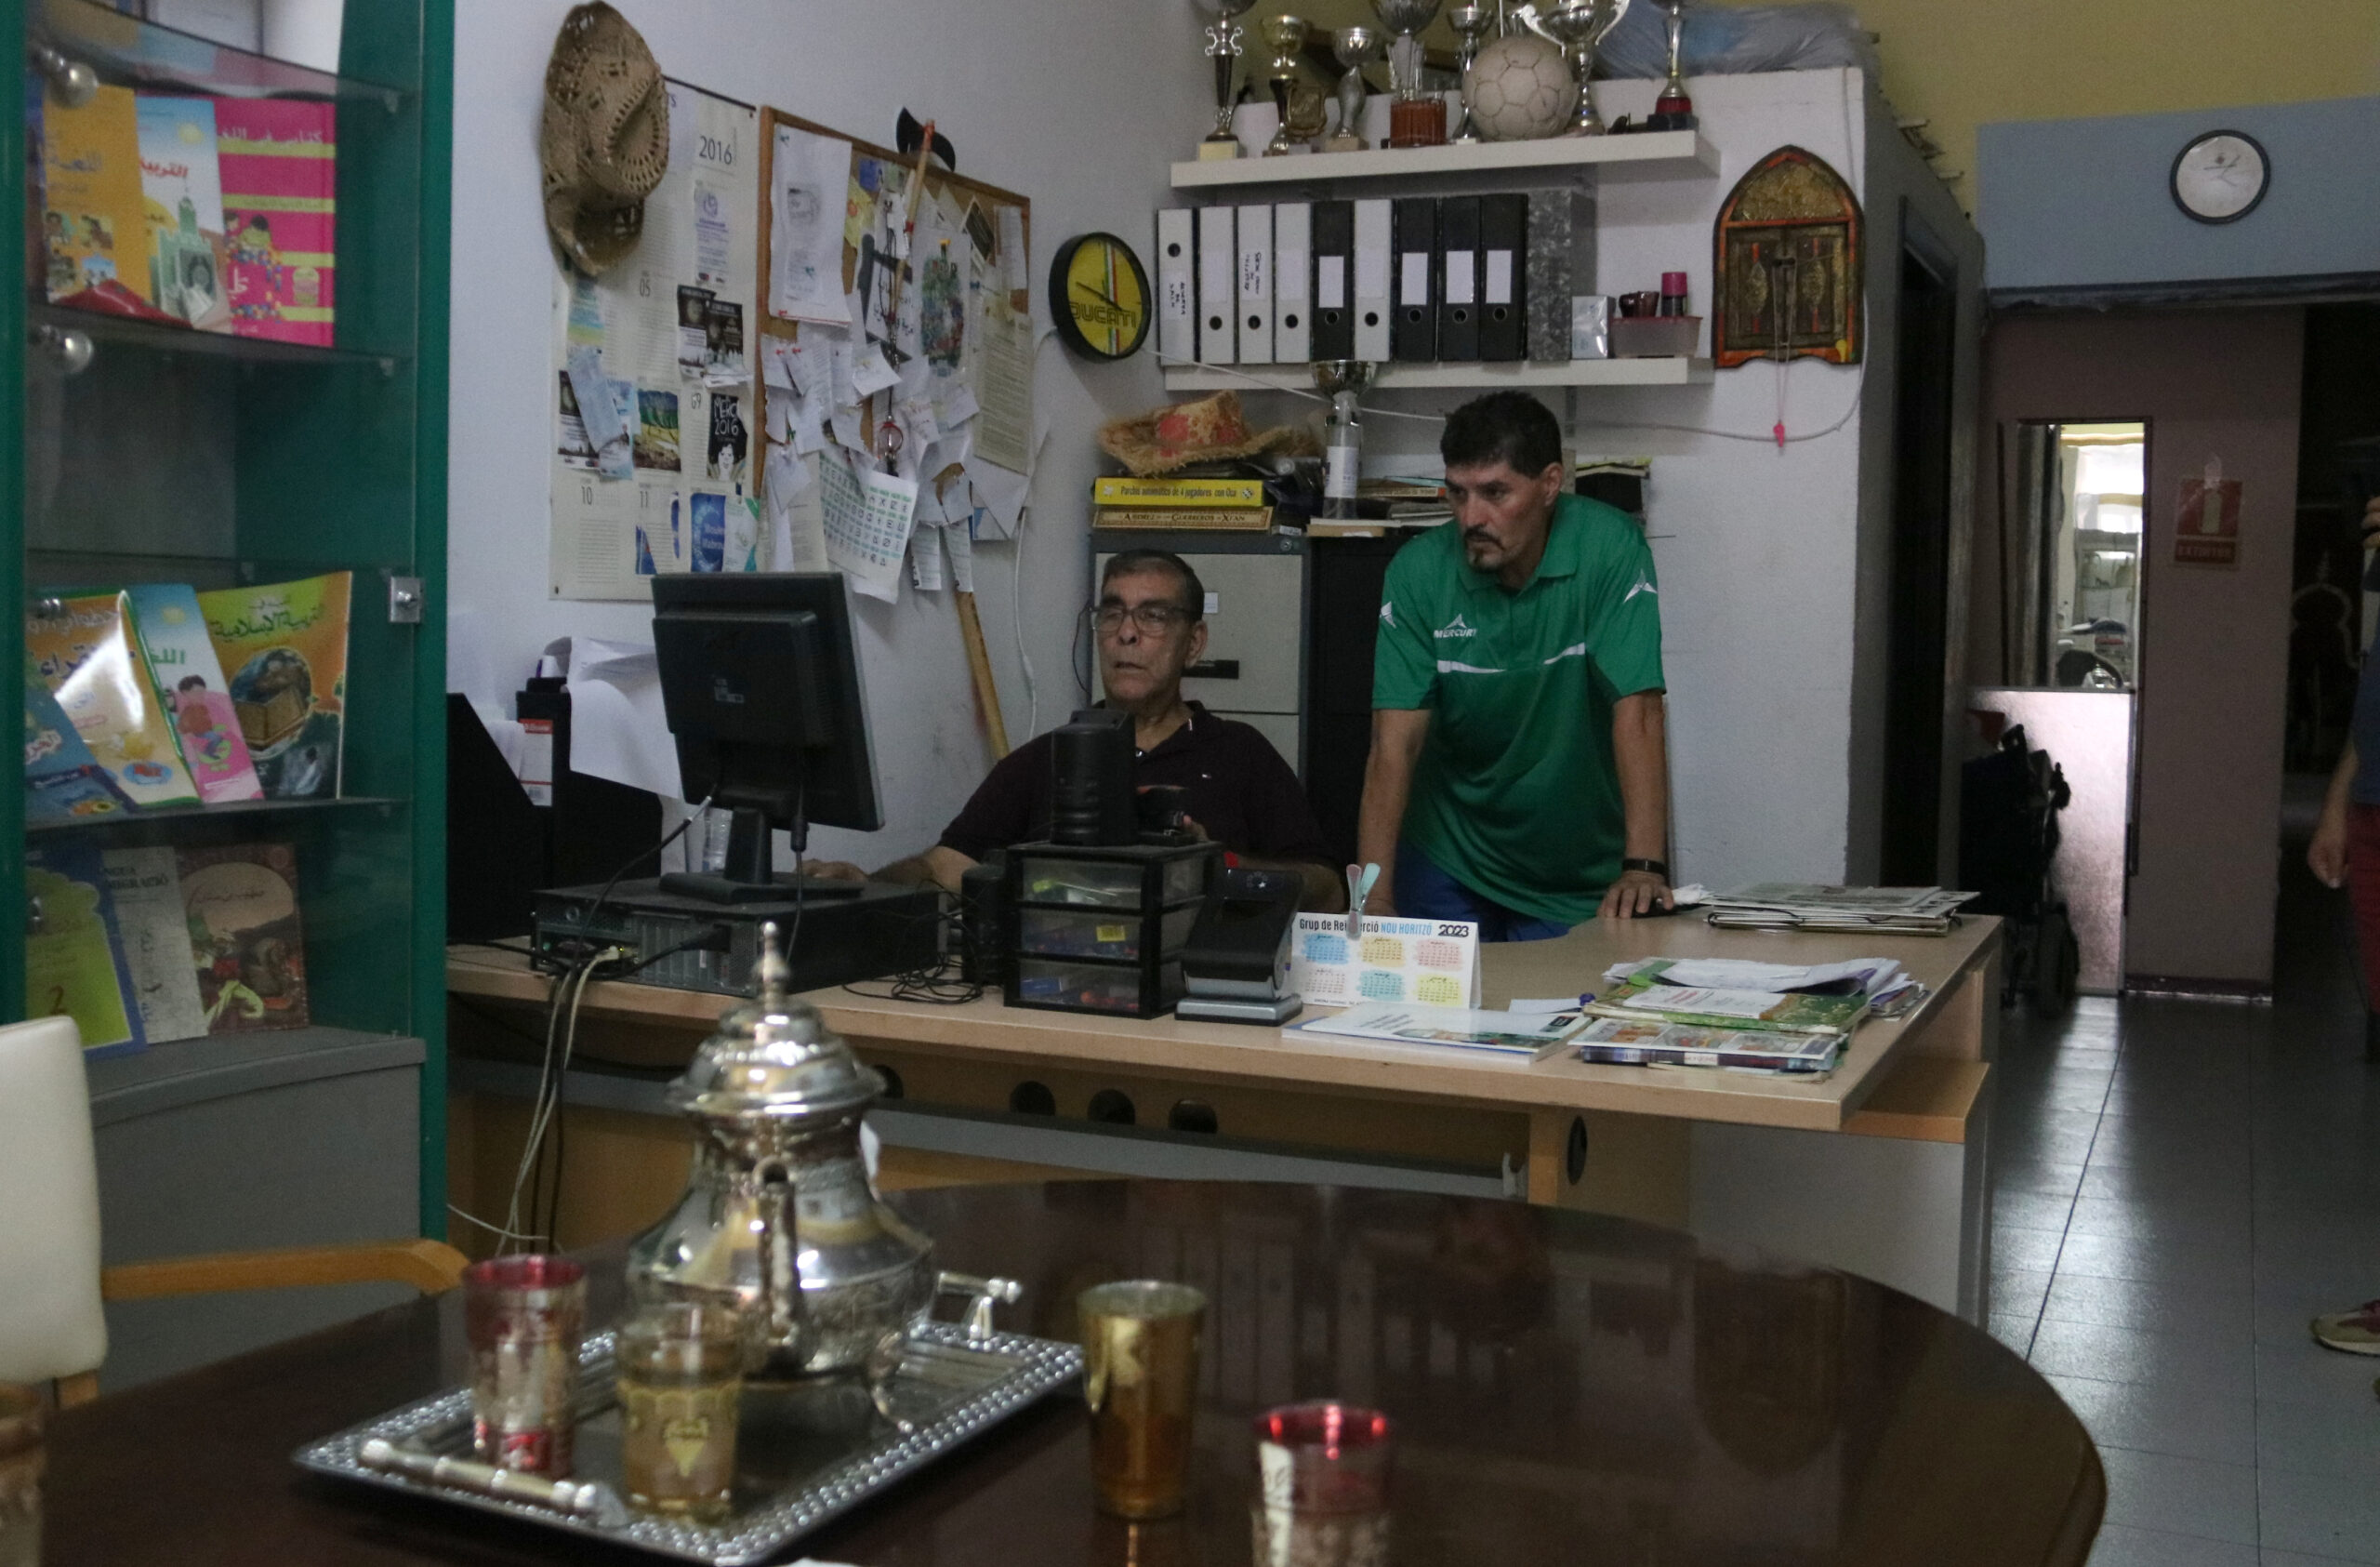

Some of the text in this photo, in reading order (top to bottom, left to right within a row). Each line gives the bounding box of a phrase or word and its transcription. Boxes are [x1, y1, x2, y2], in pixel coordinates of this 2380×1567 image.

[698, 135, 733, 165] 2016
[1069, 300, 1137, 329] DUCATI
[714, 418, 739, 436] 2016
[581, 485, 593, 506] 10
[1184, 486, 1212, 499] jugadores
[1214, 489, 1225, 498] con
[1226, 488, 1237, 498] Oca
[1171, 512, 1215, 522] GUERREROS
[1299, 918, 1470, 938] Grup de Reierció NOU HORITZÓ 2023
